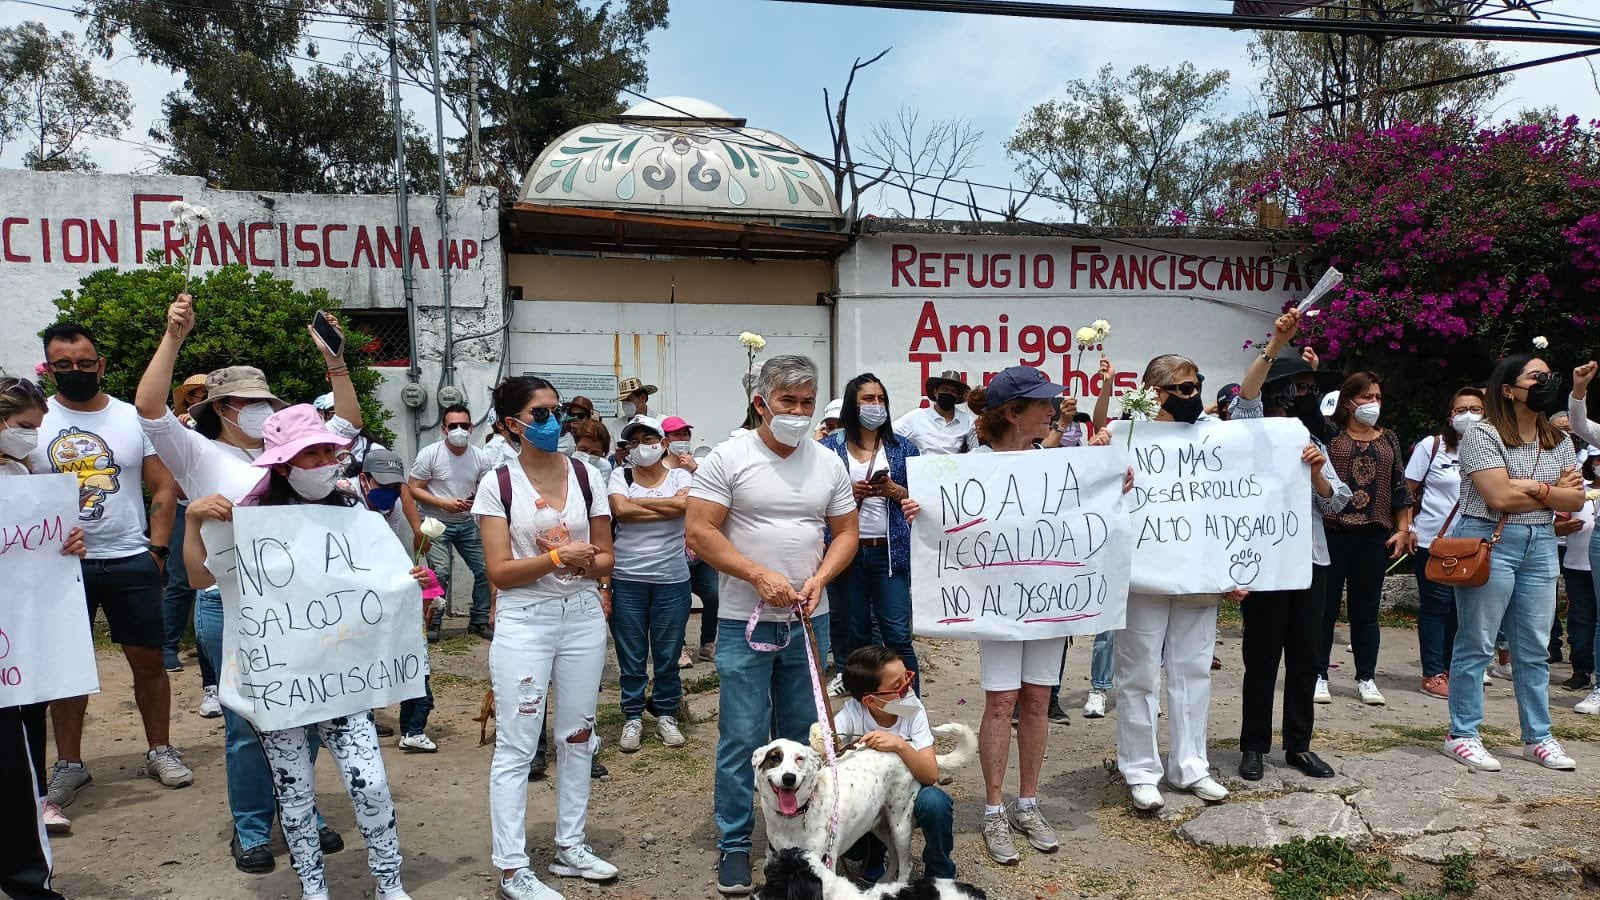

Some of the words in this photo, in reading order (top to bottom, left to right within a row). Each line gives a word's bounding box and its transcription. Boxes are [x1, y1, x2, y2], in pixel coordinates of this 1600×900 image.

[3, 217, 119, 263] CION
[133, 194, 429, 269] FRANCISCANA
[438, 239, 478, 270] IAP
[891, 244, 1055, 289] REFUGIO
[1070, 246, 1274, 291] FRANCISCANO
[1063, 354, 1138, 397] has
[1135, 444, 1166, 475] NO
[1179, 435, 1223, 479] MÁS
[940, 478, 986, 526] NO
[996, 474, 1025, 520] A
[1041, 462, 1080, 517] LA
[1130, 473, 1263, 514] DESARROLLOS
[938, 513, 1108, 578] ILEGALIDAD
[1137, 515, 1192, 550] ALTO
[1221, 510, 1299, 551] DESALOJO
[235, 537, 295, 597] NO
[325, 533, 371, 573] AL
[941, 585, 971, 617] NO
[981, 584, 1008, 617] AL
[1014, 572, 1108, 622] DESALOJO
[239, 644, 287, 676] DEL
[242, 653, 420, 713] FRANCISCANO
